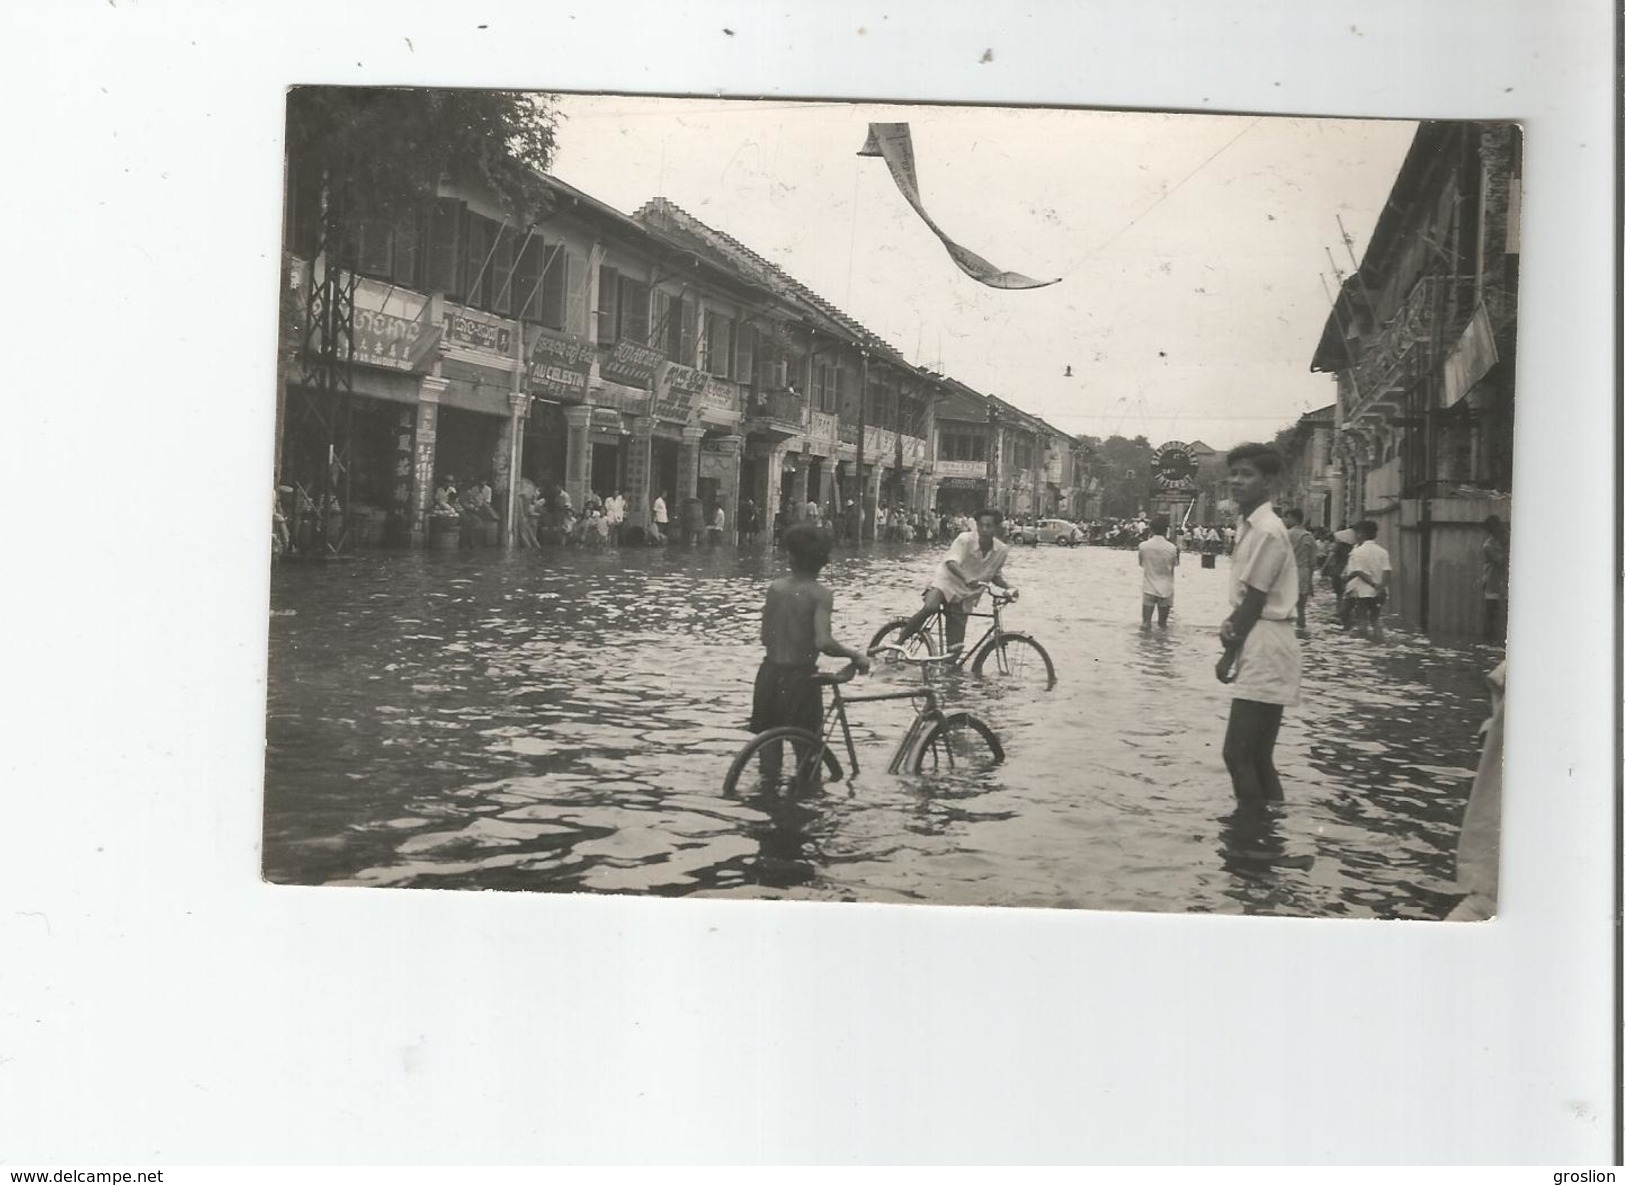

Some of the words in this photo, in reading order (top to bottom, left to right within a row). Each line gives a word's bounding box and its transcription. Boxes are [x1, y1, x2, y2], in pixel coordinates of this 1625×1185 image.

[534, 364, 547, 379] AU
[1151, 441, 1199, 466] STATIONNEMENT
[1154, 474, 1193, 488] INTERDIT
